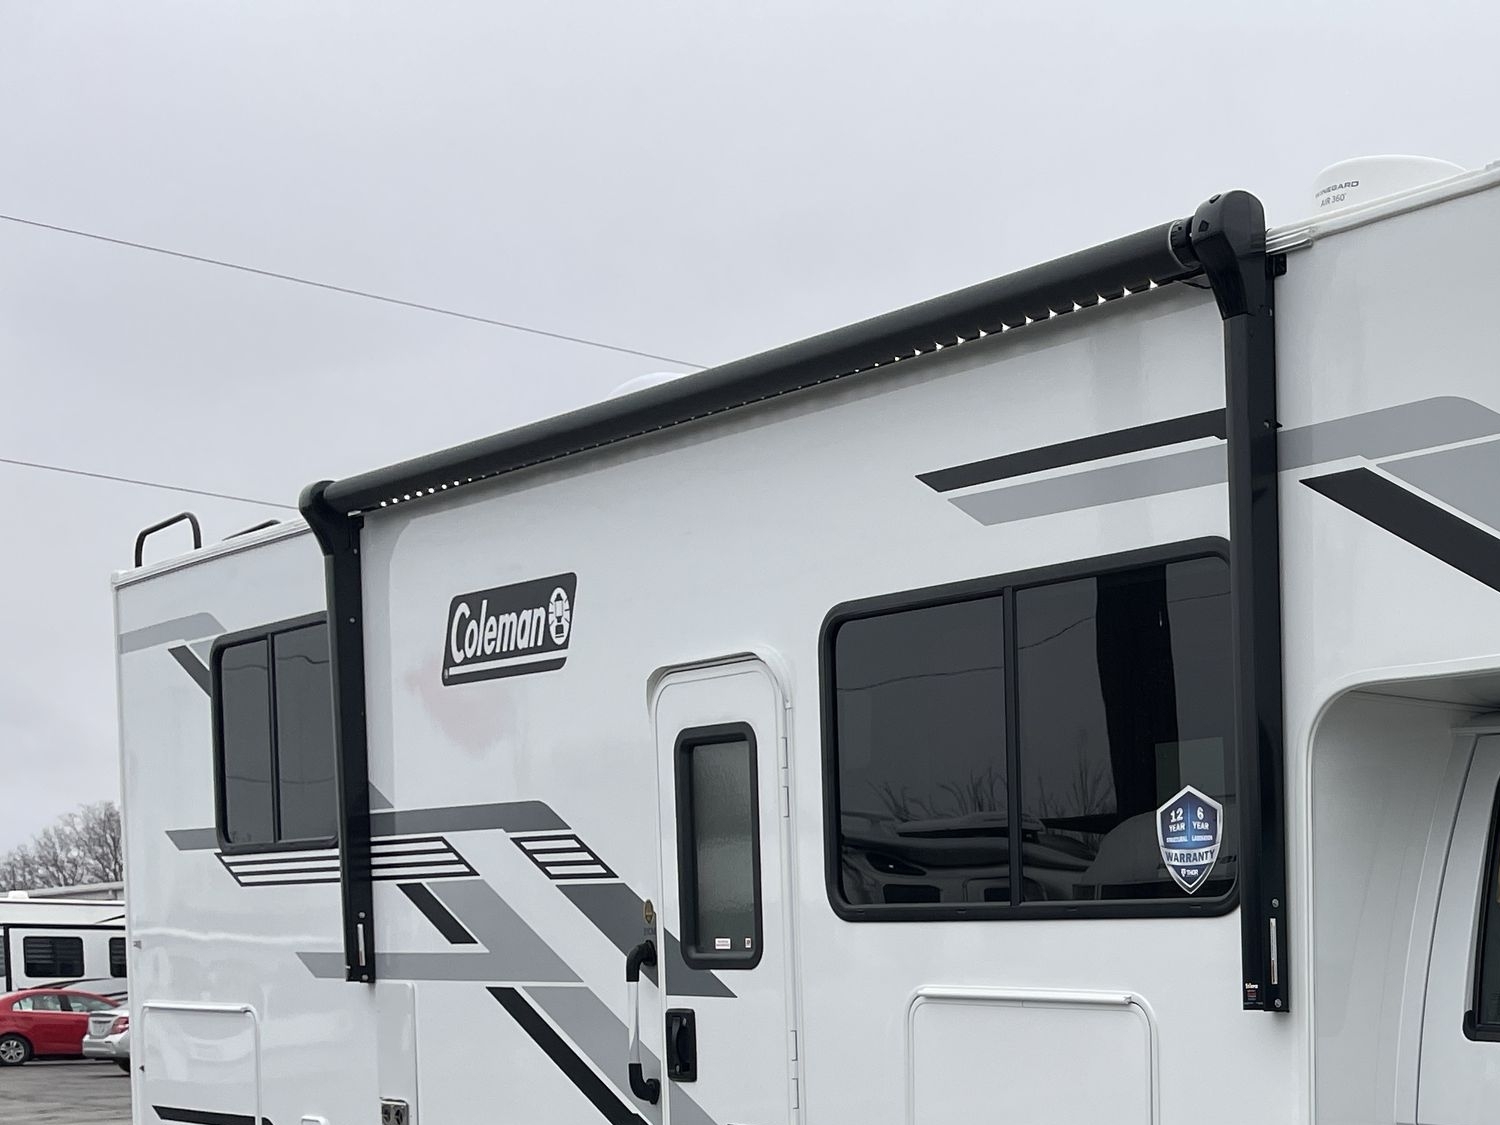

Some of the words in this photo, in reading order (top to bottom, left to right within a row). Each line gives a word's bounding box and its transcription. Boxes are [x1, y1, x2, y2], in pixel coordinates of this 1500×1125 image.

[450, 599, 546, 664] Coleman
[1170, 807, 1184, 823] 12
[1196, 806, 1204, 821] 6
[1169, 822, 1185, 832] YEAR
[1192, 821, 1209, 831] YEAR
[1165, 849, 1215, 863] WARRANTY
